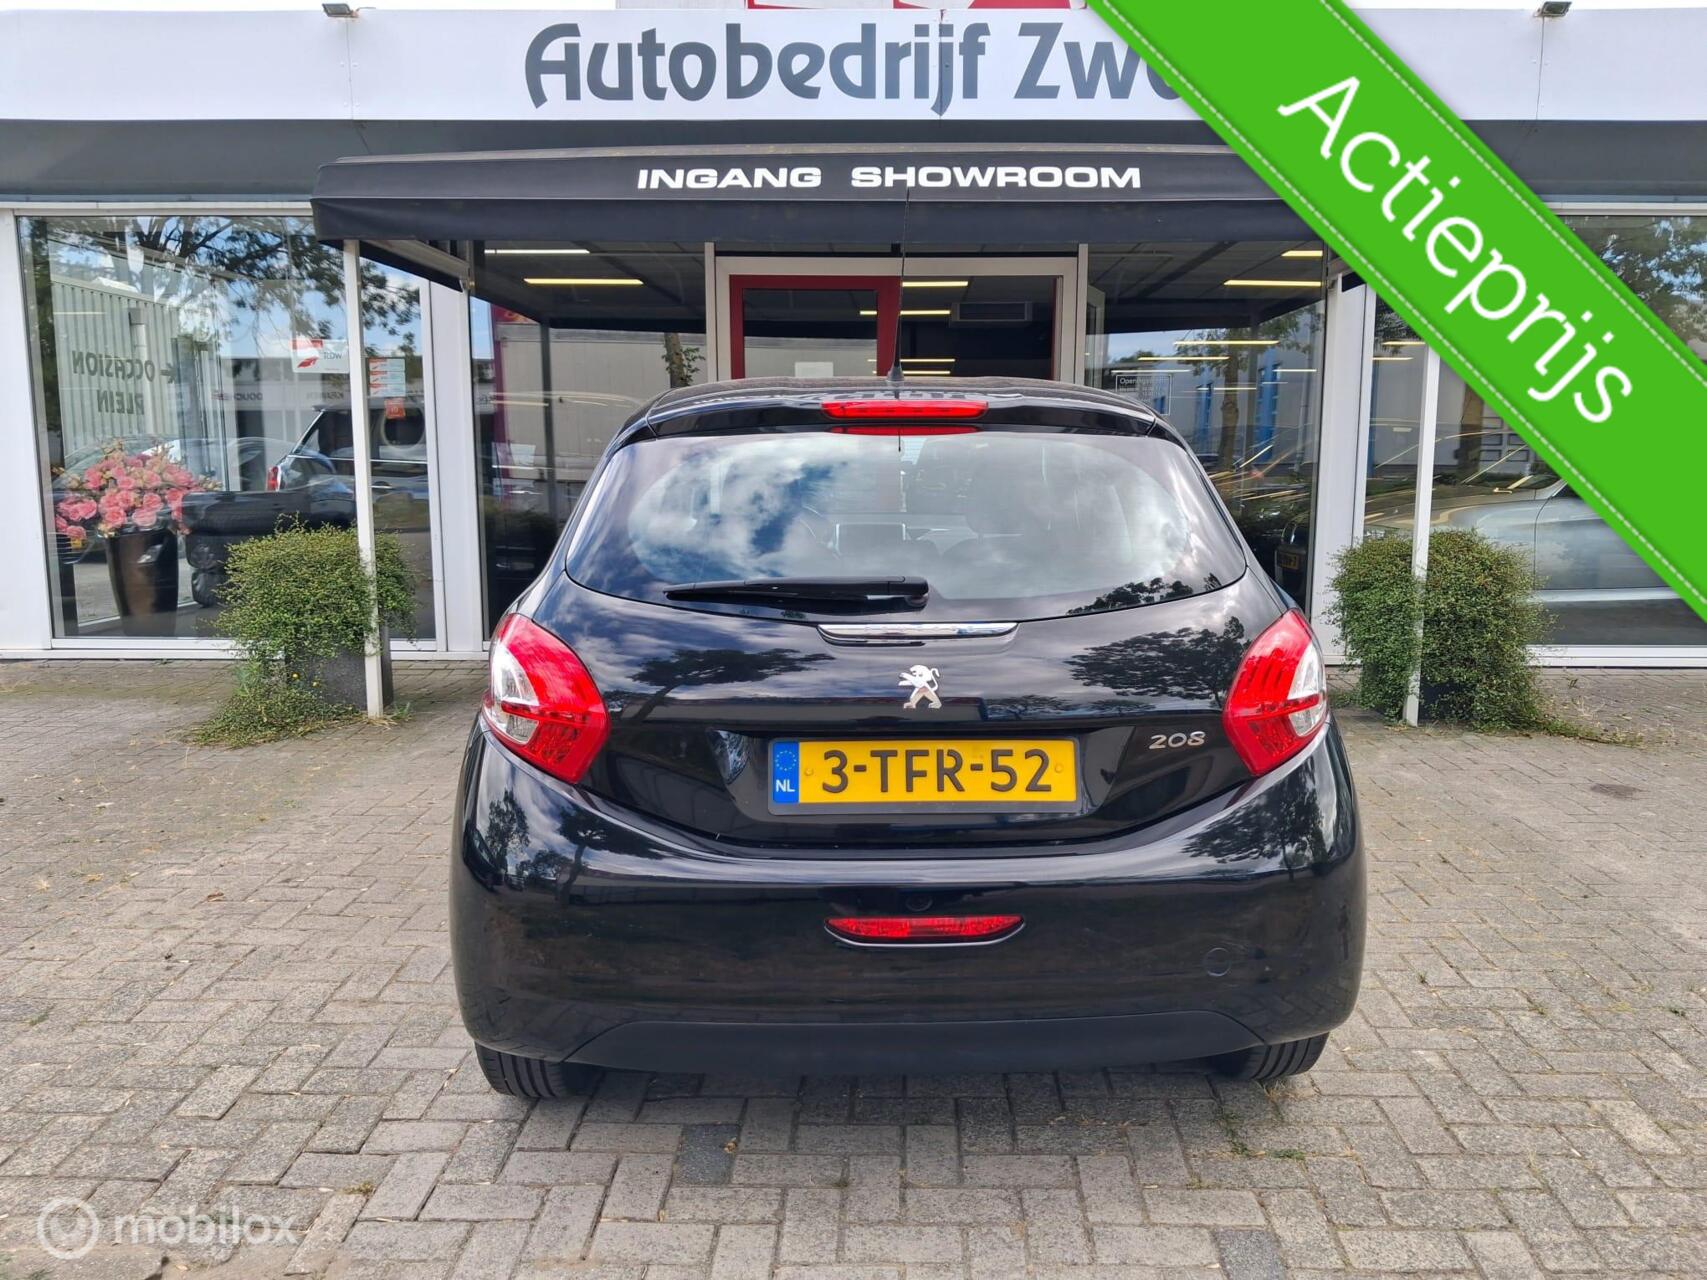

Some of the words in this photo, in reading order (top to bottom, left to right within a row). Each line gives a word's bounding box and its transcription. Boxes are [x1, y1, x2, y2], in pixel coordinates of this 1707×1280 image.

[524, 22, 991, 118] Autobedrijf
[637, 167, 821, 189] INGANG
[851, 166, 1142, 189] SHOWROOM
[1148, 730, 1206, 751] 208
[821, 749, 1053, 794] 3-TFR-52
[775, 778, 796, 793] NL
